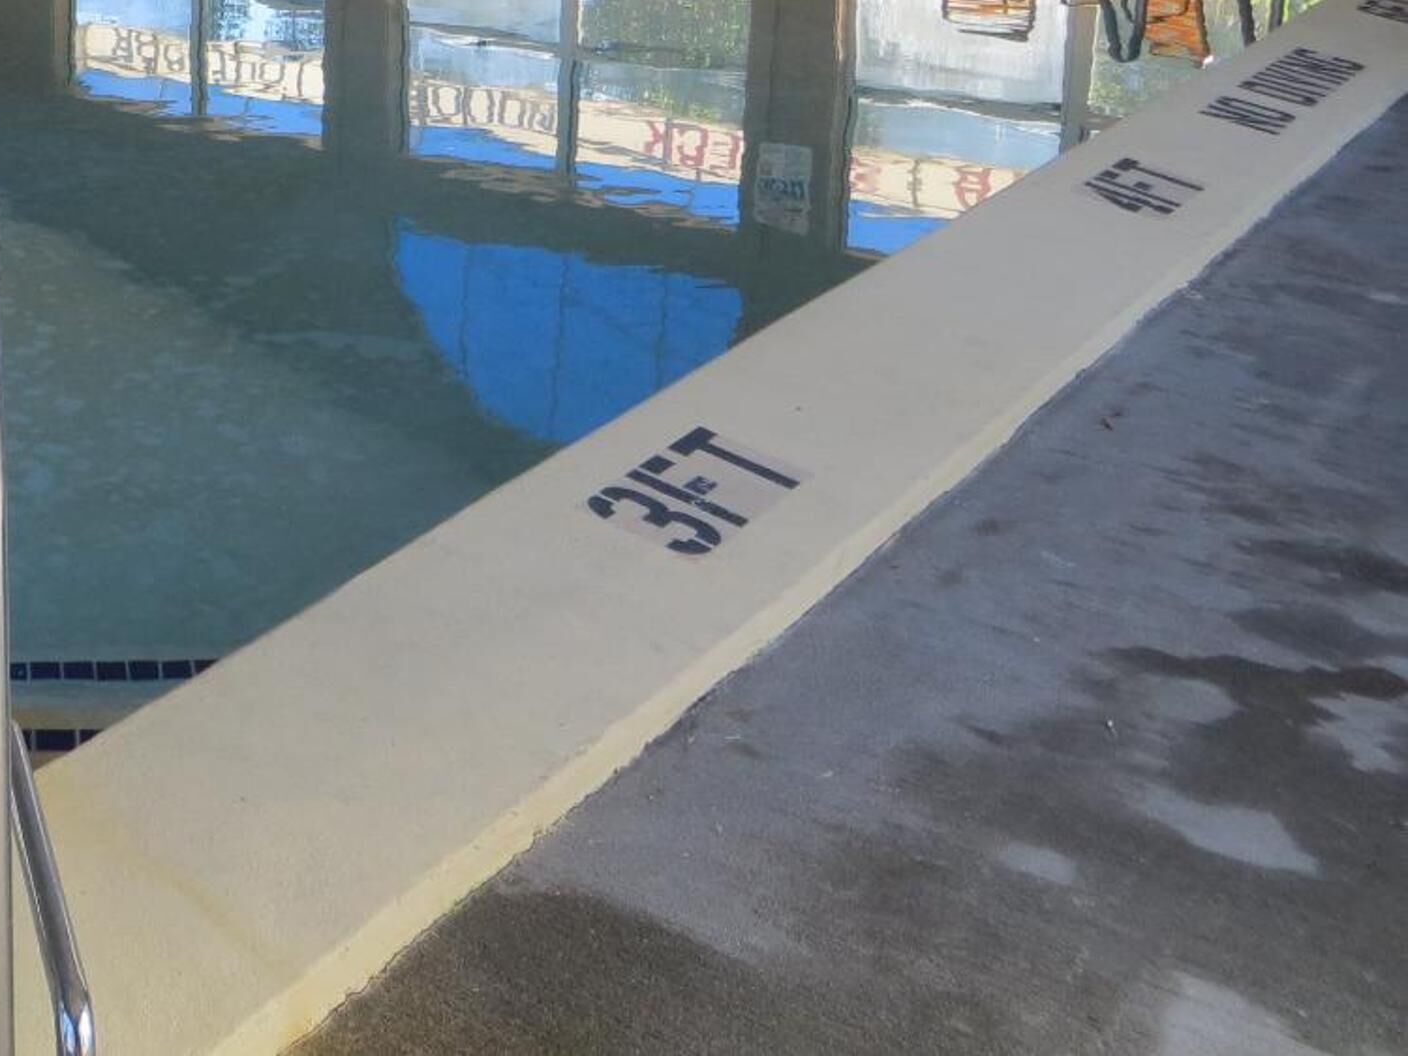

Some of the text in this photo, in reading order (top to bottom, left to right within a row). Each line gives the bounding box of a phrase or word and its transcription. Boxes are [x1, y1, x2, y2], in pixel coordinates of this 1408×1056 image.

[1198, 47, 1366, 135] NO DIVING
[1083, 157, 1205, 213] 4FT
[587, 426, 801, 556] 3FT
